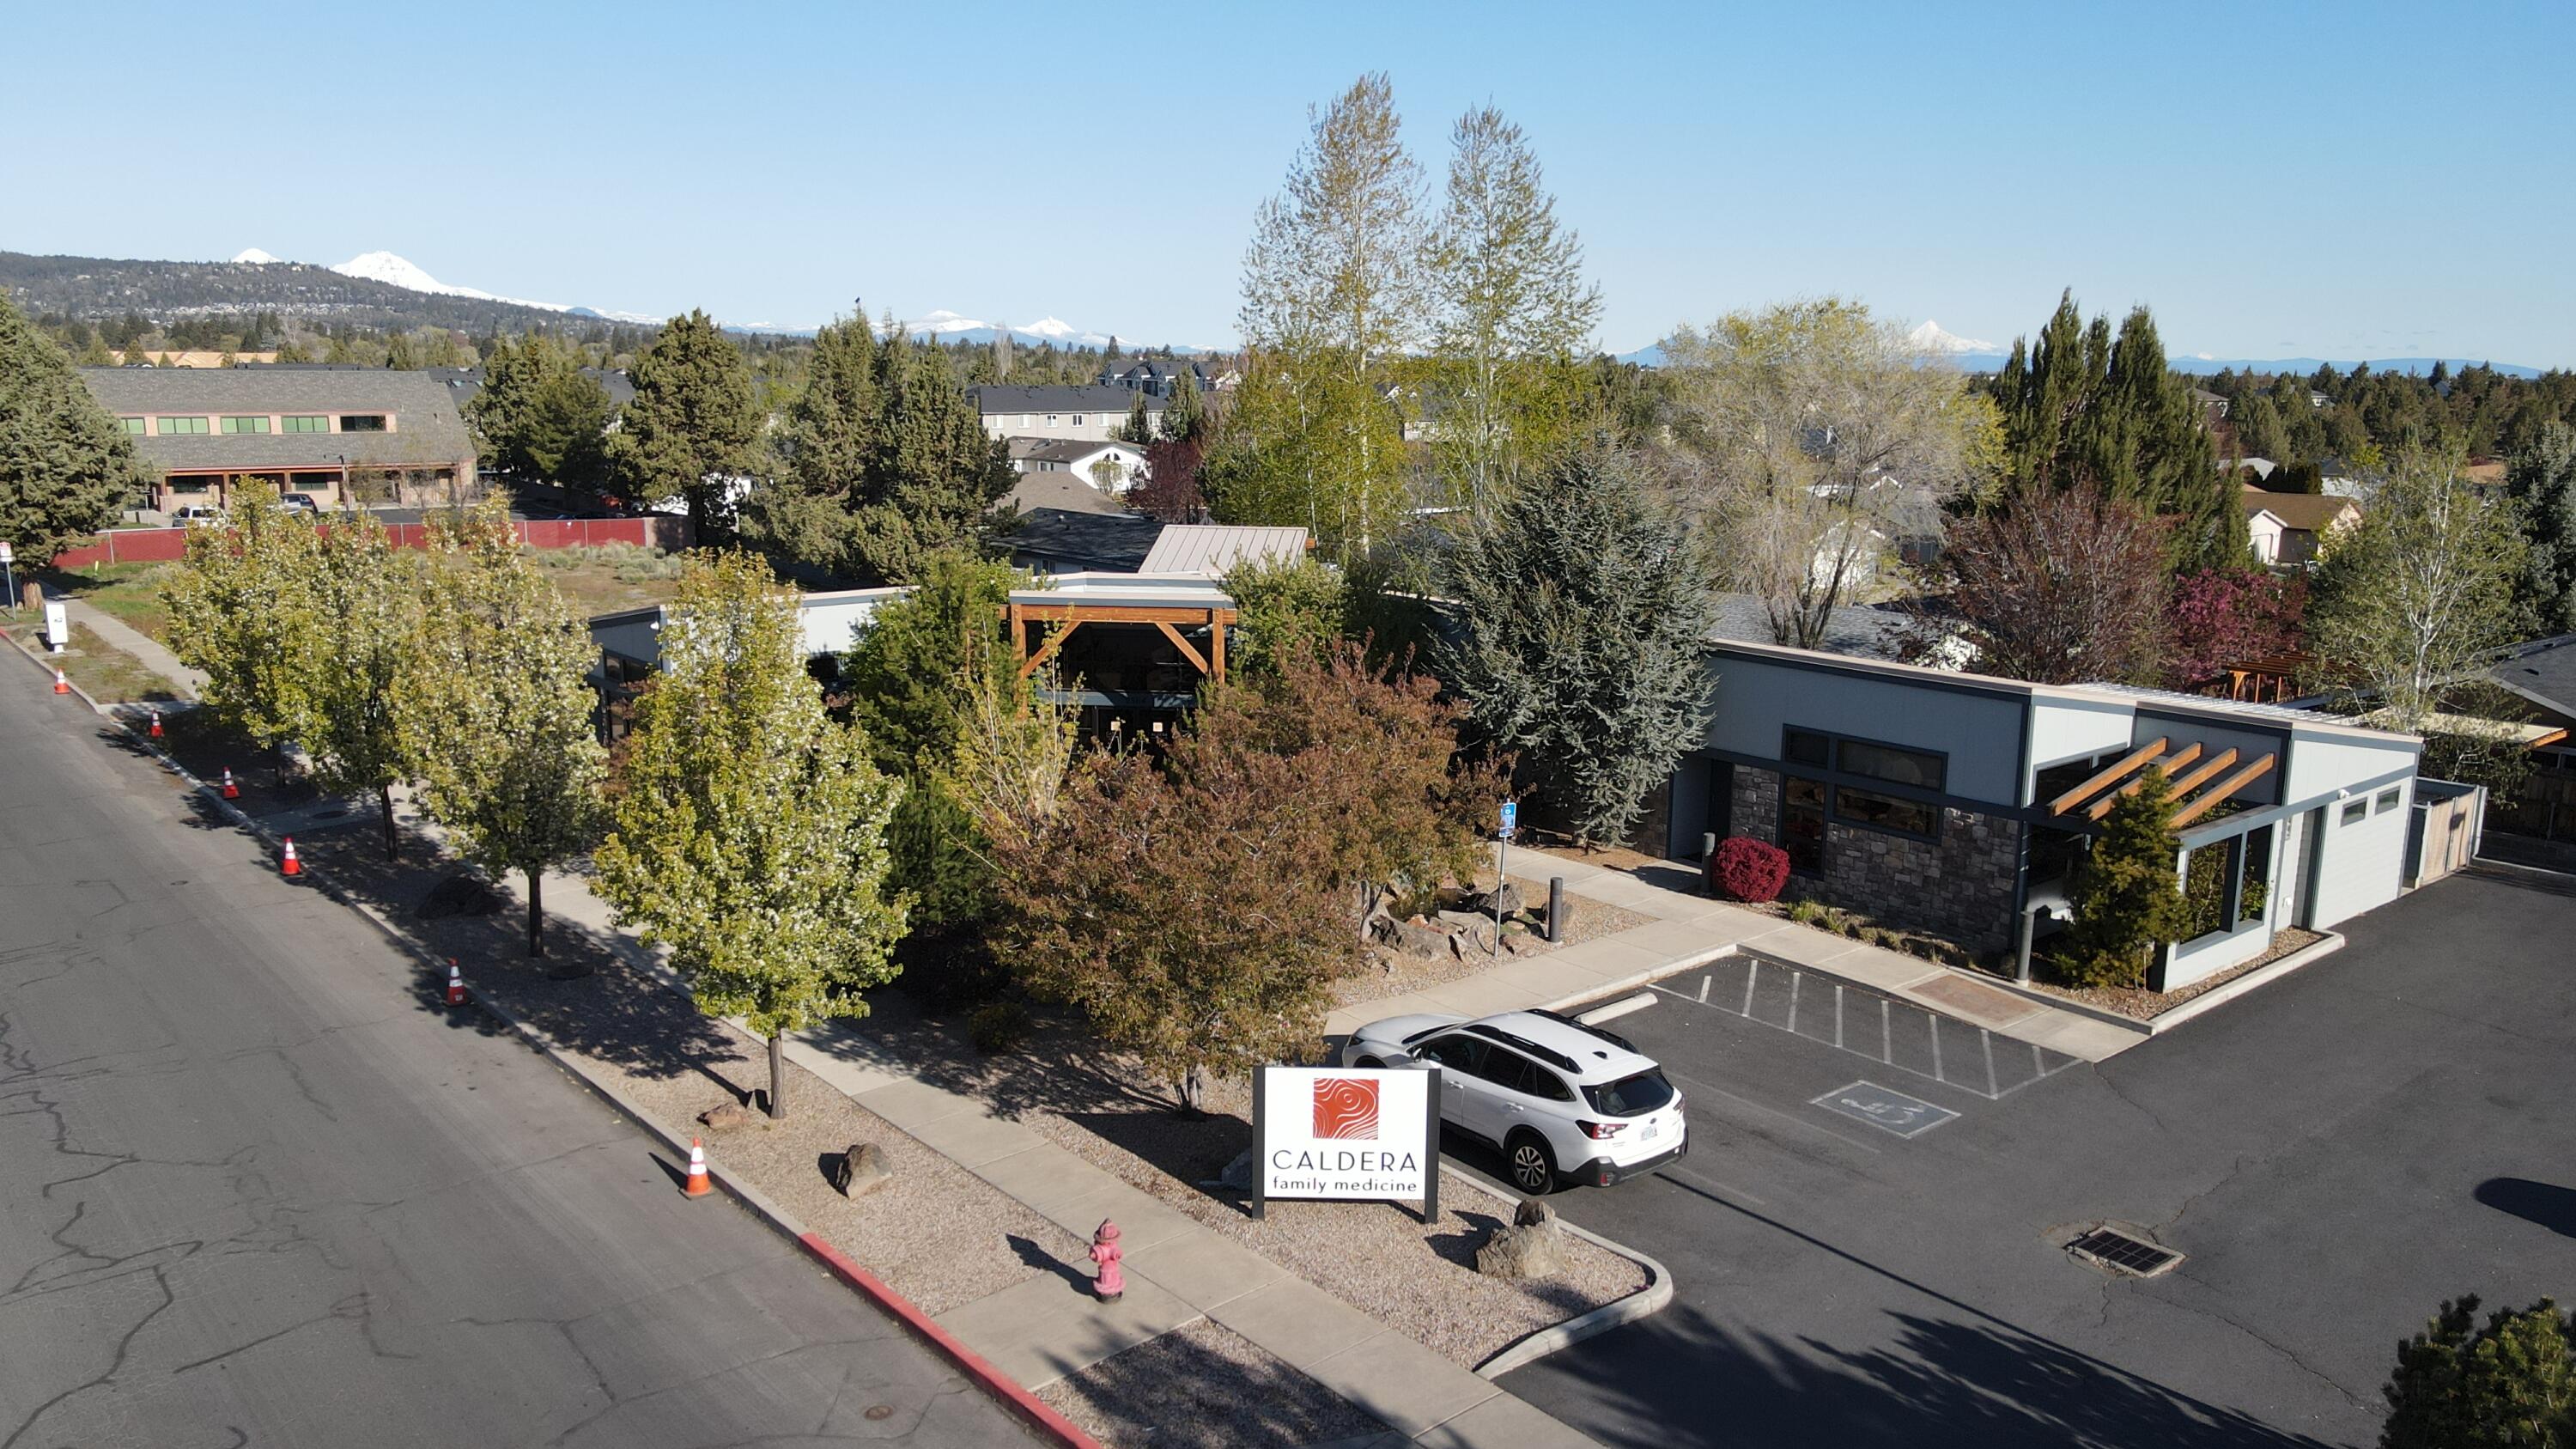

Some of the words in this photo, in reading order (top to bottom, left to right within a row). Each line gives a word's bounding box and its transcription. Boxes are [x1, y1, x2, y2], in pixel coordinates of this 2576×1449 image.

[1273, 1149, 1417, 1172] CALDERA
[1273, 1176, 1327, 1194] family
[1334, 1178, 1417, 1192] medicine
